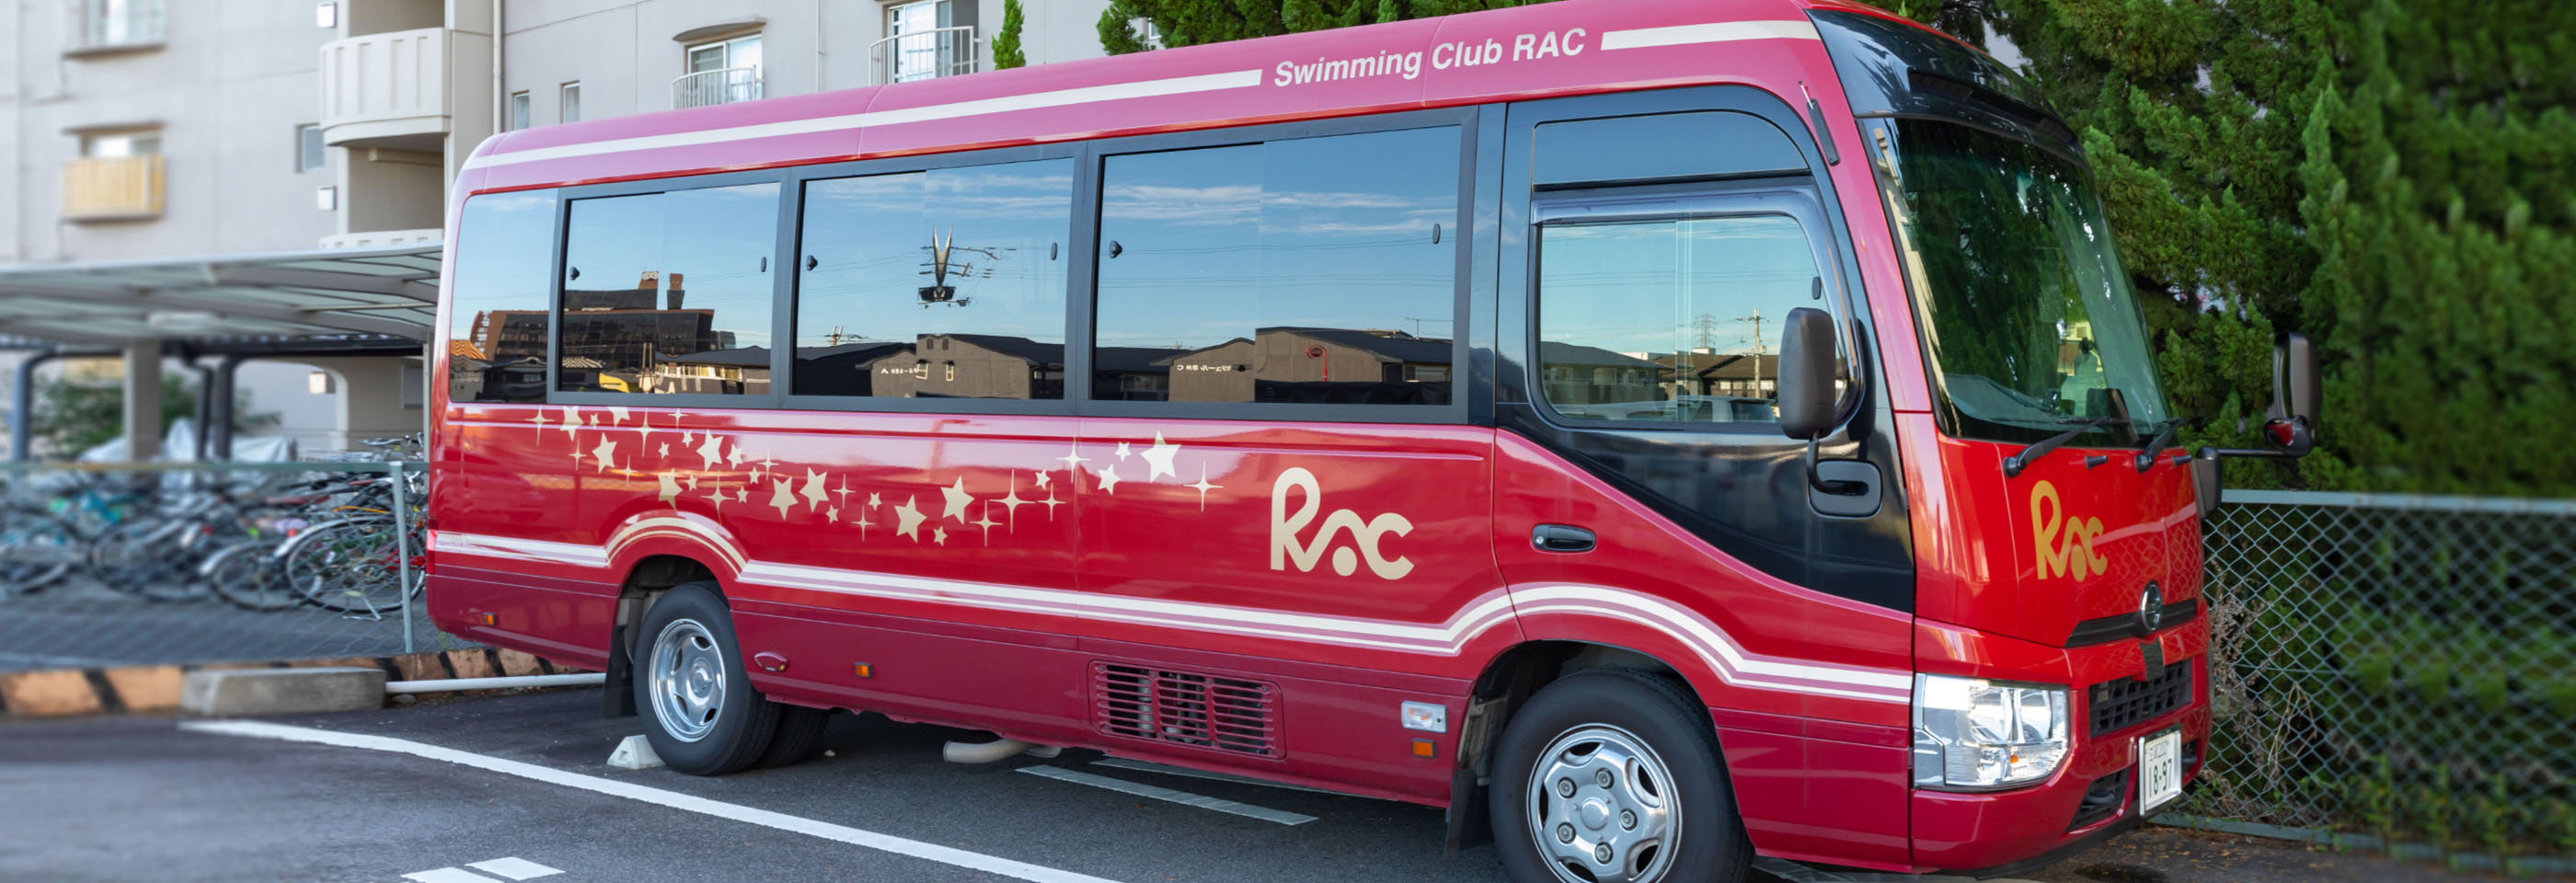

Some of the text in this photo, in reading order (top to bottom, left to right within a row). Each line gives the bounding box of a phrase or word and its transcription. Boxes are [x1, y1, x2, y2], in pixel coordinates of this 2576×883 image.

[1274, 28, 1586, 86] Swimming Club RAC
